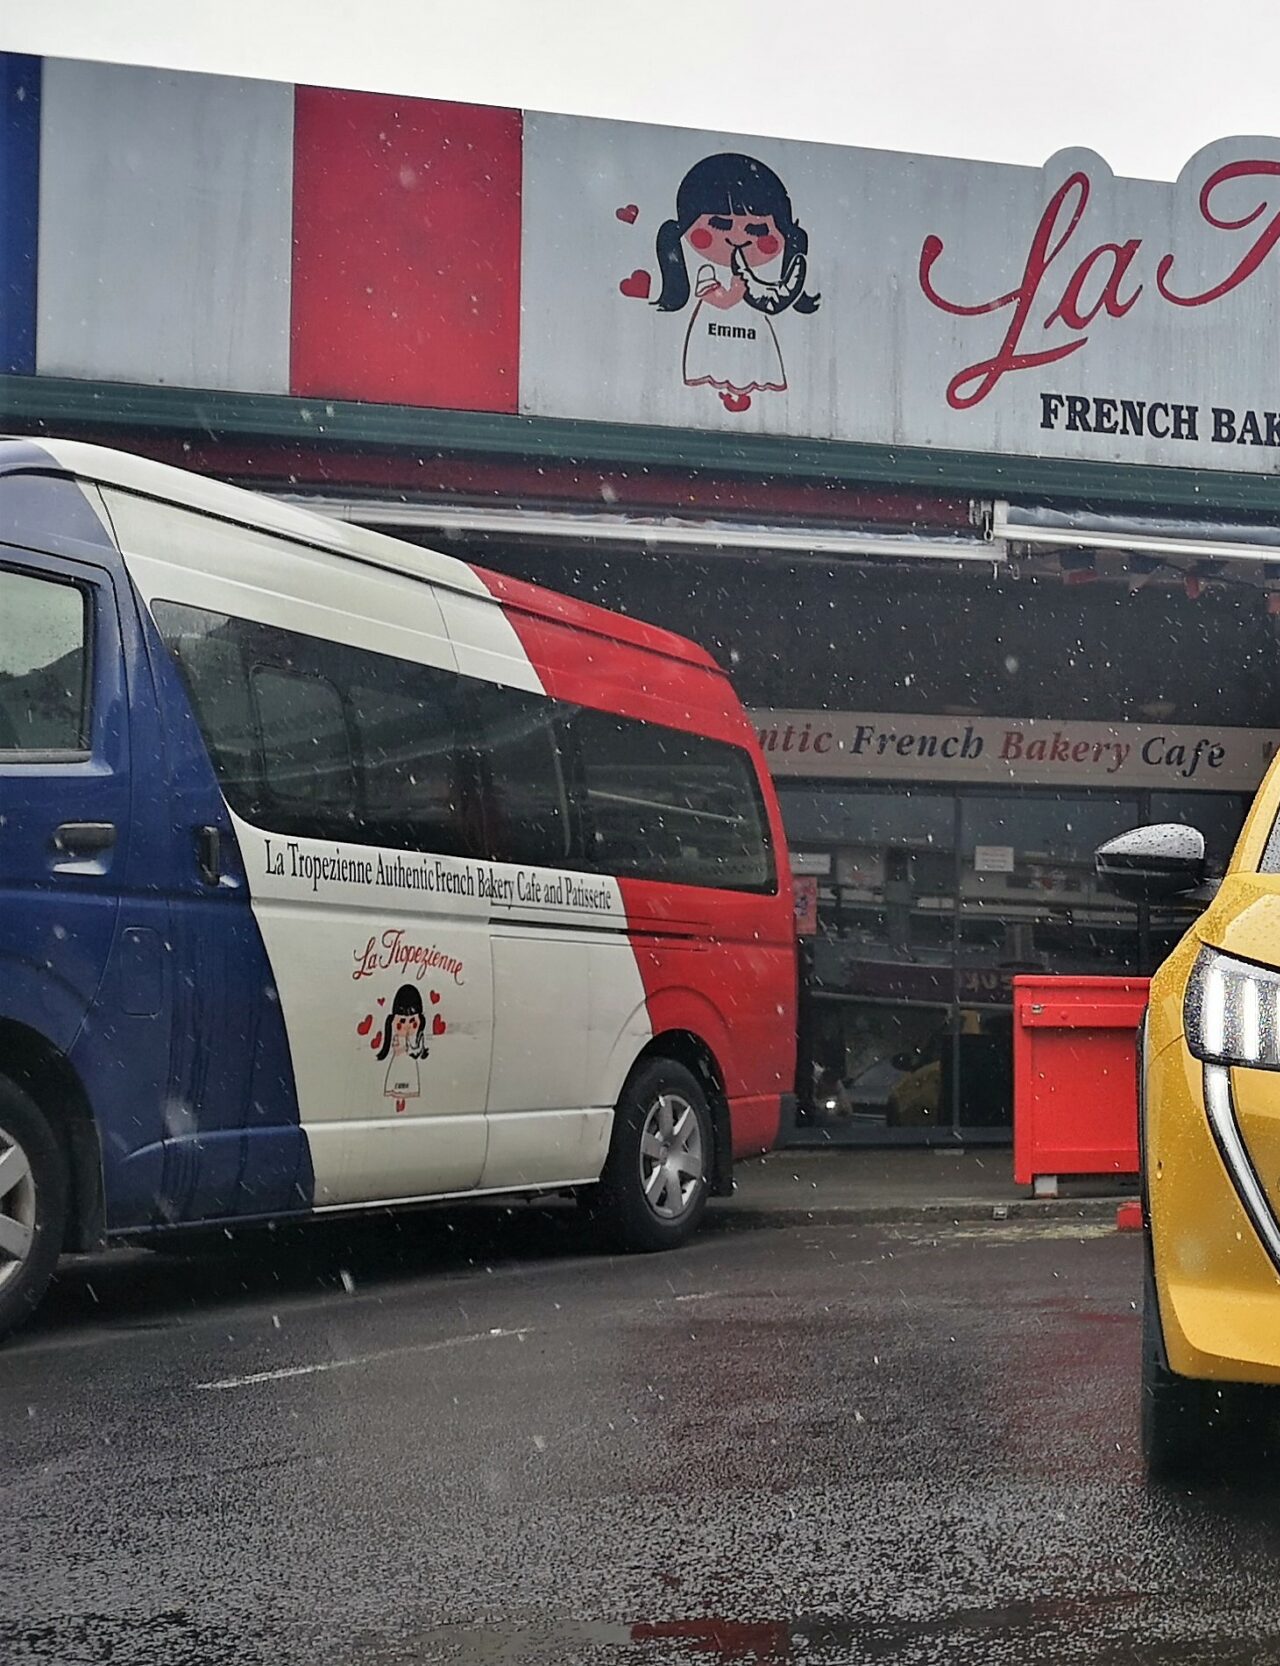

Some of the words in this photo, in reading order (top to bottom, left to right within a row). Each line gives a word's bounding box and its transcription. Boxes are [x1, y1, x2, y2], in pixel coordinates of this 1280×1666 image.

[918, 170, 1144, 411] La
[707, 320, 757, 342] Emma
[1040, 392, 1199, 442] FRENCH
[850, 724, 985, 760] French
[998, 731, 1131, 773] Bakery
[1141, 736, 1225, 778] Café
[264, 839, 285, 876] La
[287, 842, 373, 892] Tropezienne
[375, 853, 435, 892] Authentic
[435, 861, 475, 896] French
[477, 867, 514, 910] Bakery
[516, 871, 541, 902] Cafe
[543, 876, 562, 906] and
[564, 877, 613, 910] Patisserie
[352, 936, 378, 981] La
[379, 929, 465, 986] Tropezienne
